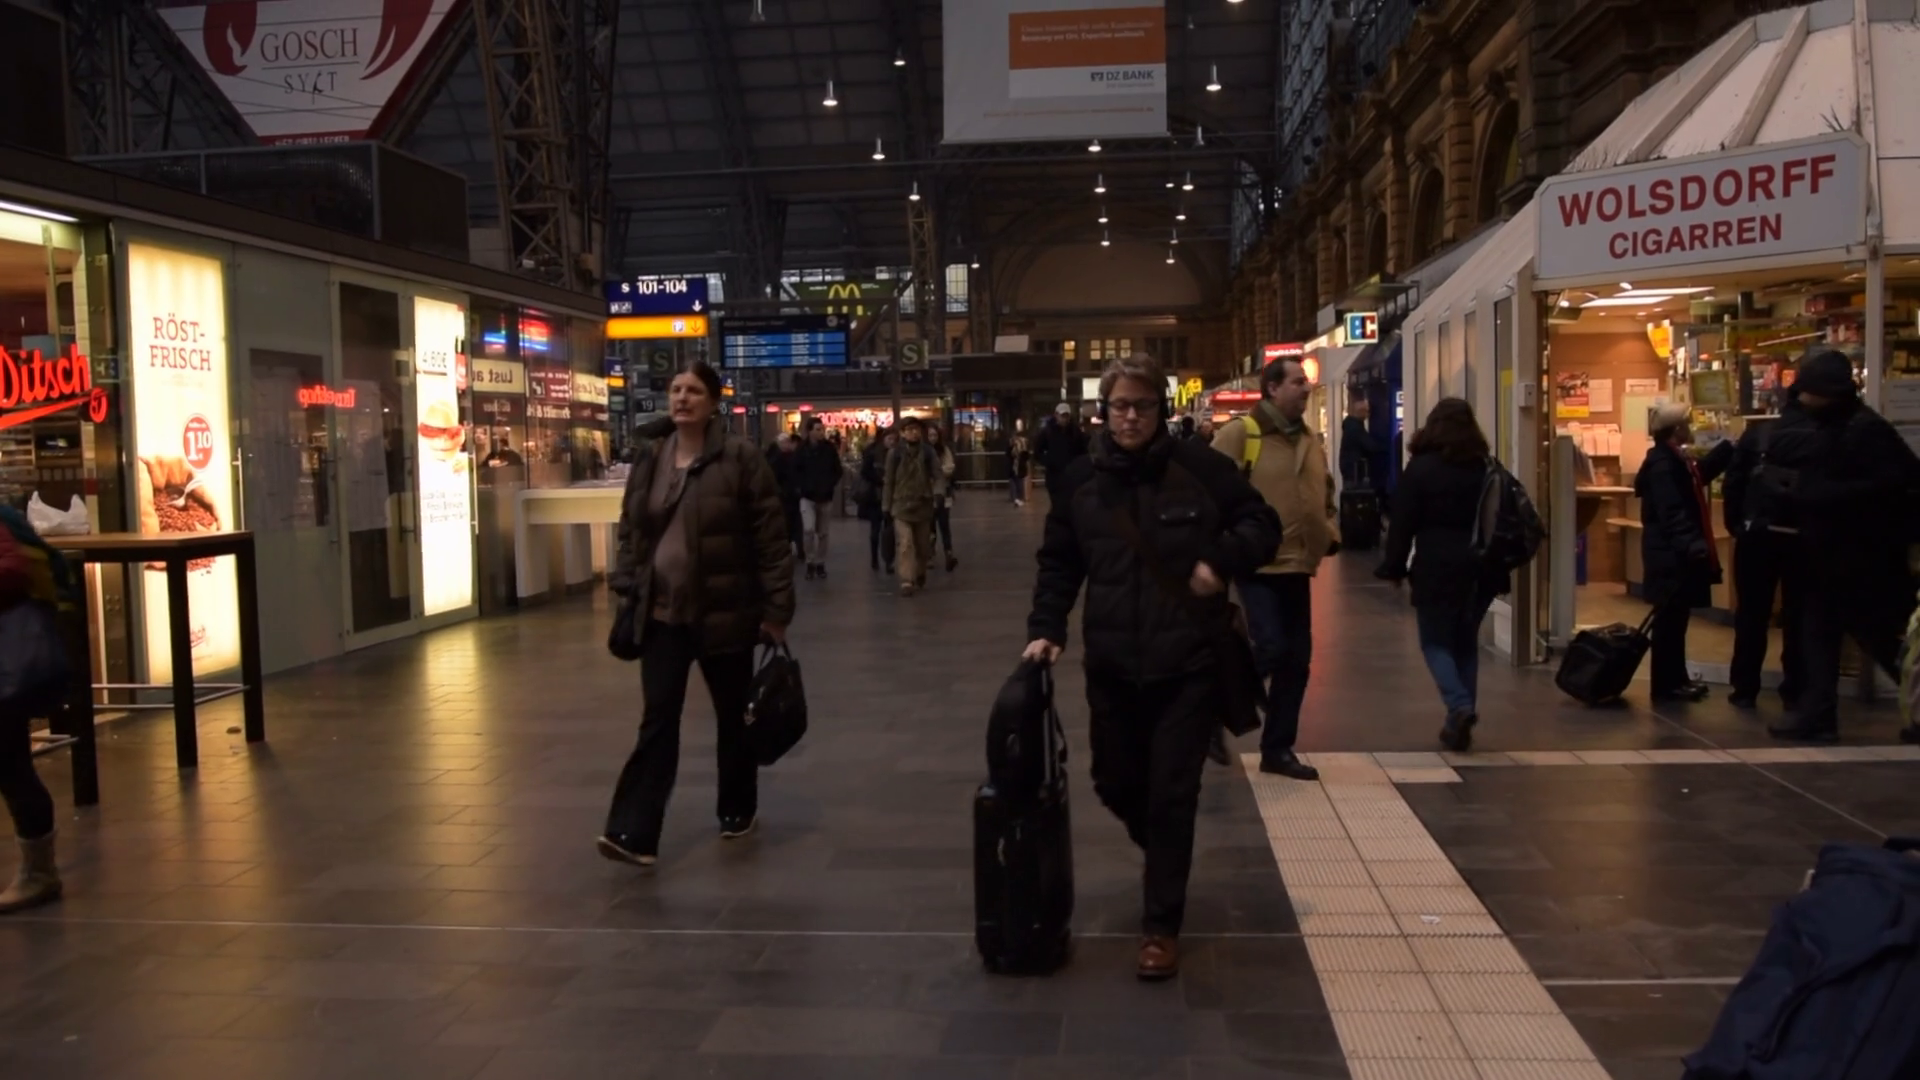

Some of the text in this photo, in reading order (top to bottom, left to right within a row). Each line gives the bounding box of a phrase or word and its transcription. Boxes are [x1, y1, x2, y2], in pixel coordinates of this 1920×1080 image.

[260, 28, 358, 63] GOSCH
[1106, 70, 1154, 81] DZ BANK
[1558, 154, 1836, 227] WOLSDORFF
[1609, 213, 1782, 259] CIGARREN
[636, 280, 688, 295] 101-104
[153, 313, 206, 343] RÖST-
[149, 345, 212, 371] FRISCH
[653, 350, 669, 371] S
[902, 343, 919, 364] S
[641, 400, 654, 411] 19
